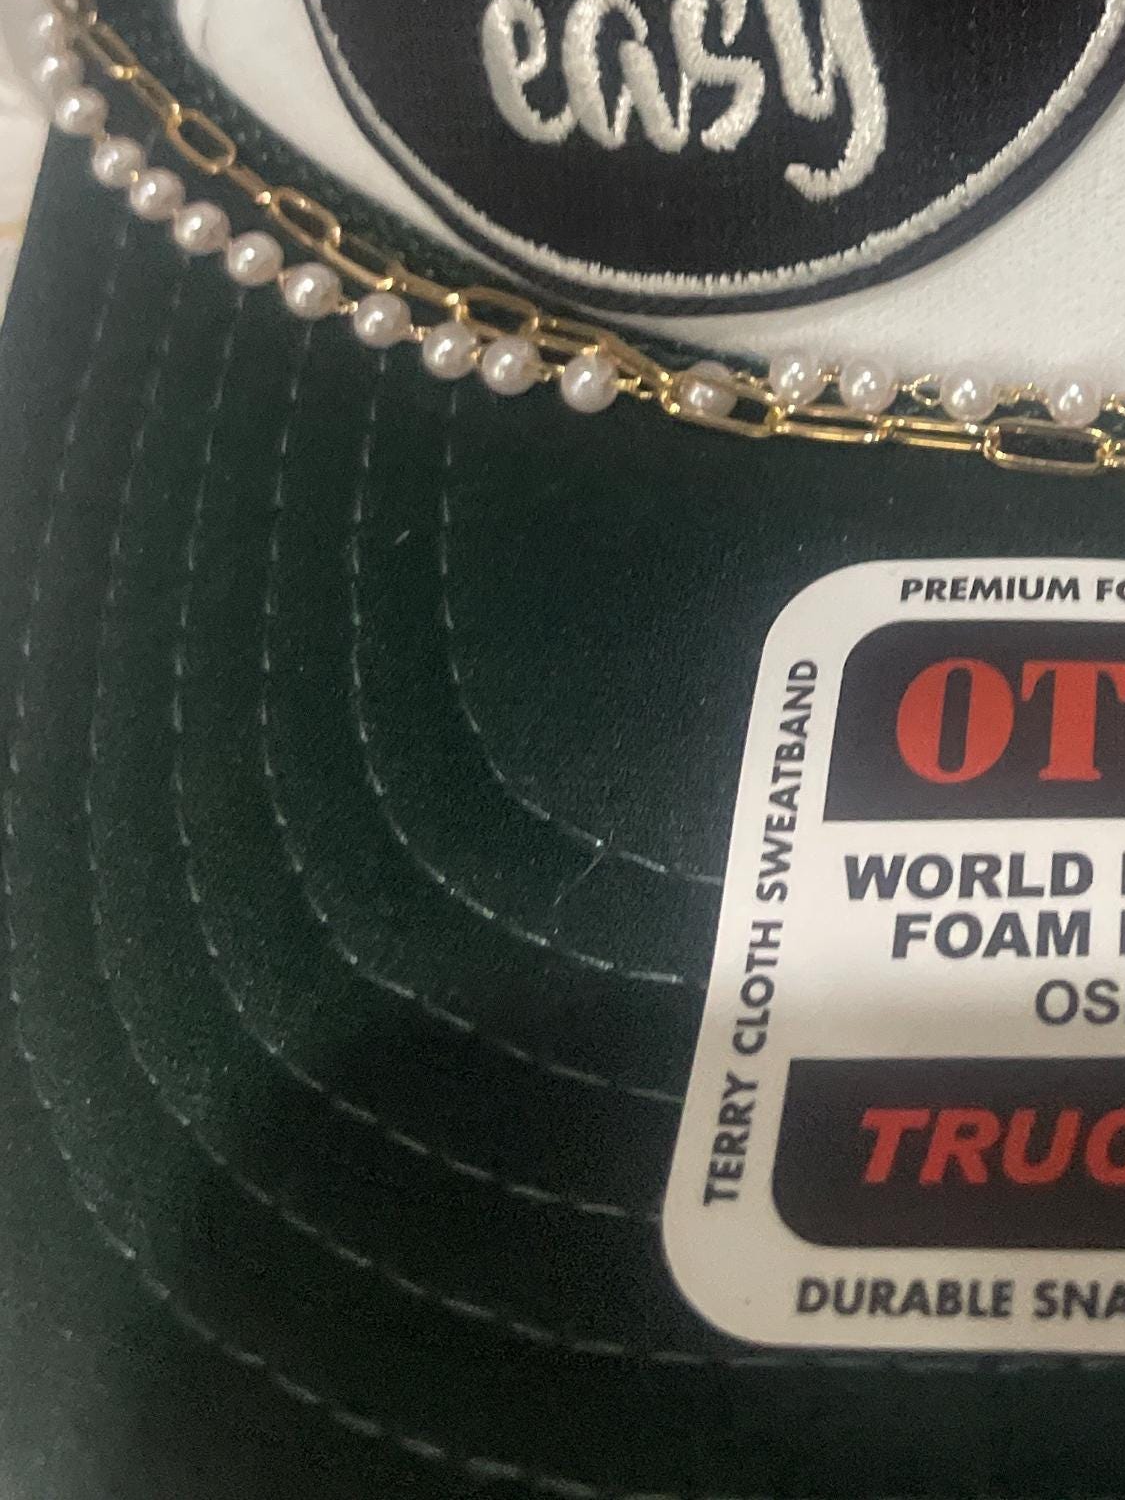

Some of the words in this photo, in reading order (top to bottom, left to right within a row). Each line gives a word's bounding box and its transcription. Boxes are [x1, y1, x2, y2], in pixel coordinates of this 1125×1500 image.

[900, 576, 1081, 602] PREMIUM
[757, 659, 818, 904] SWEATBAND
[844, 851, 1094, 901] WORLD
[892, 910, 1091, 959] FOAM
[733, 919, 783, 1056] CLOTH
[704, 1071, 758, 1207] TERRY
[796, 1276, 1014, 1319] DURABLE
